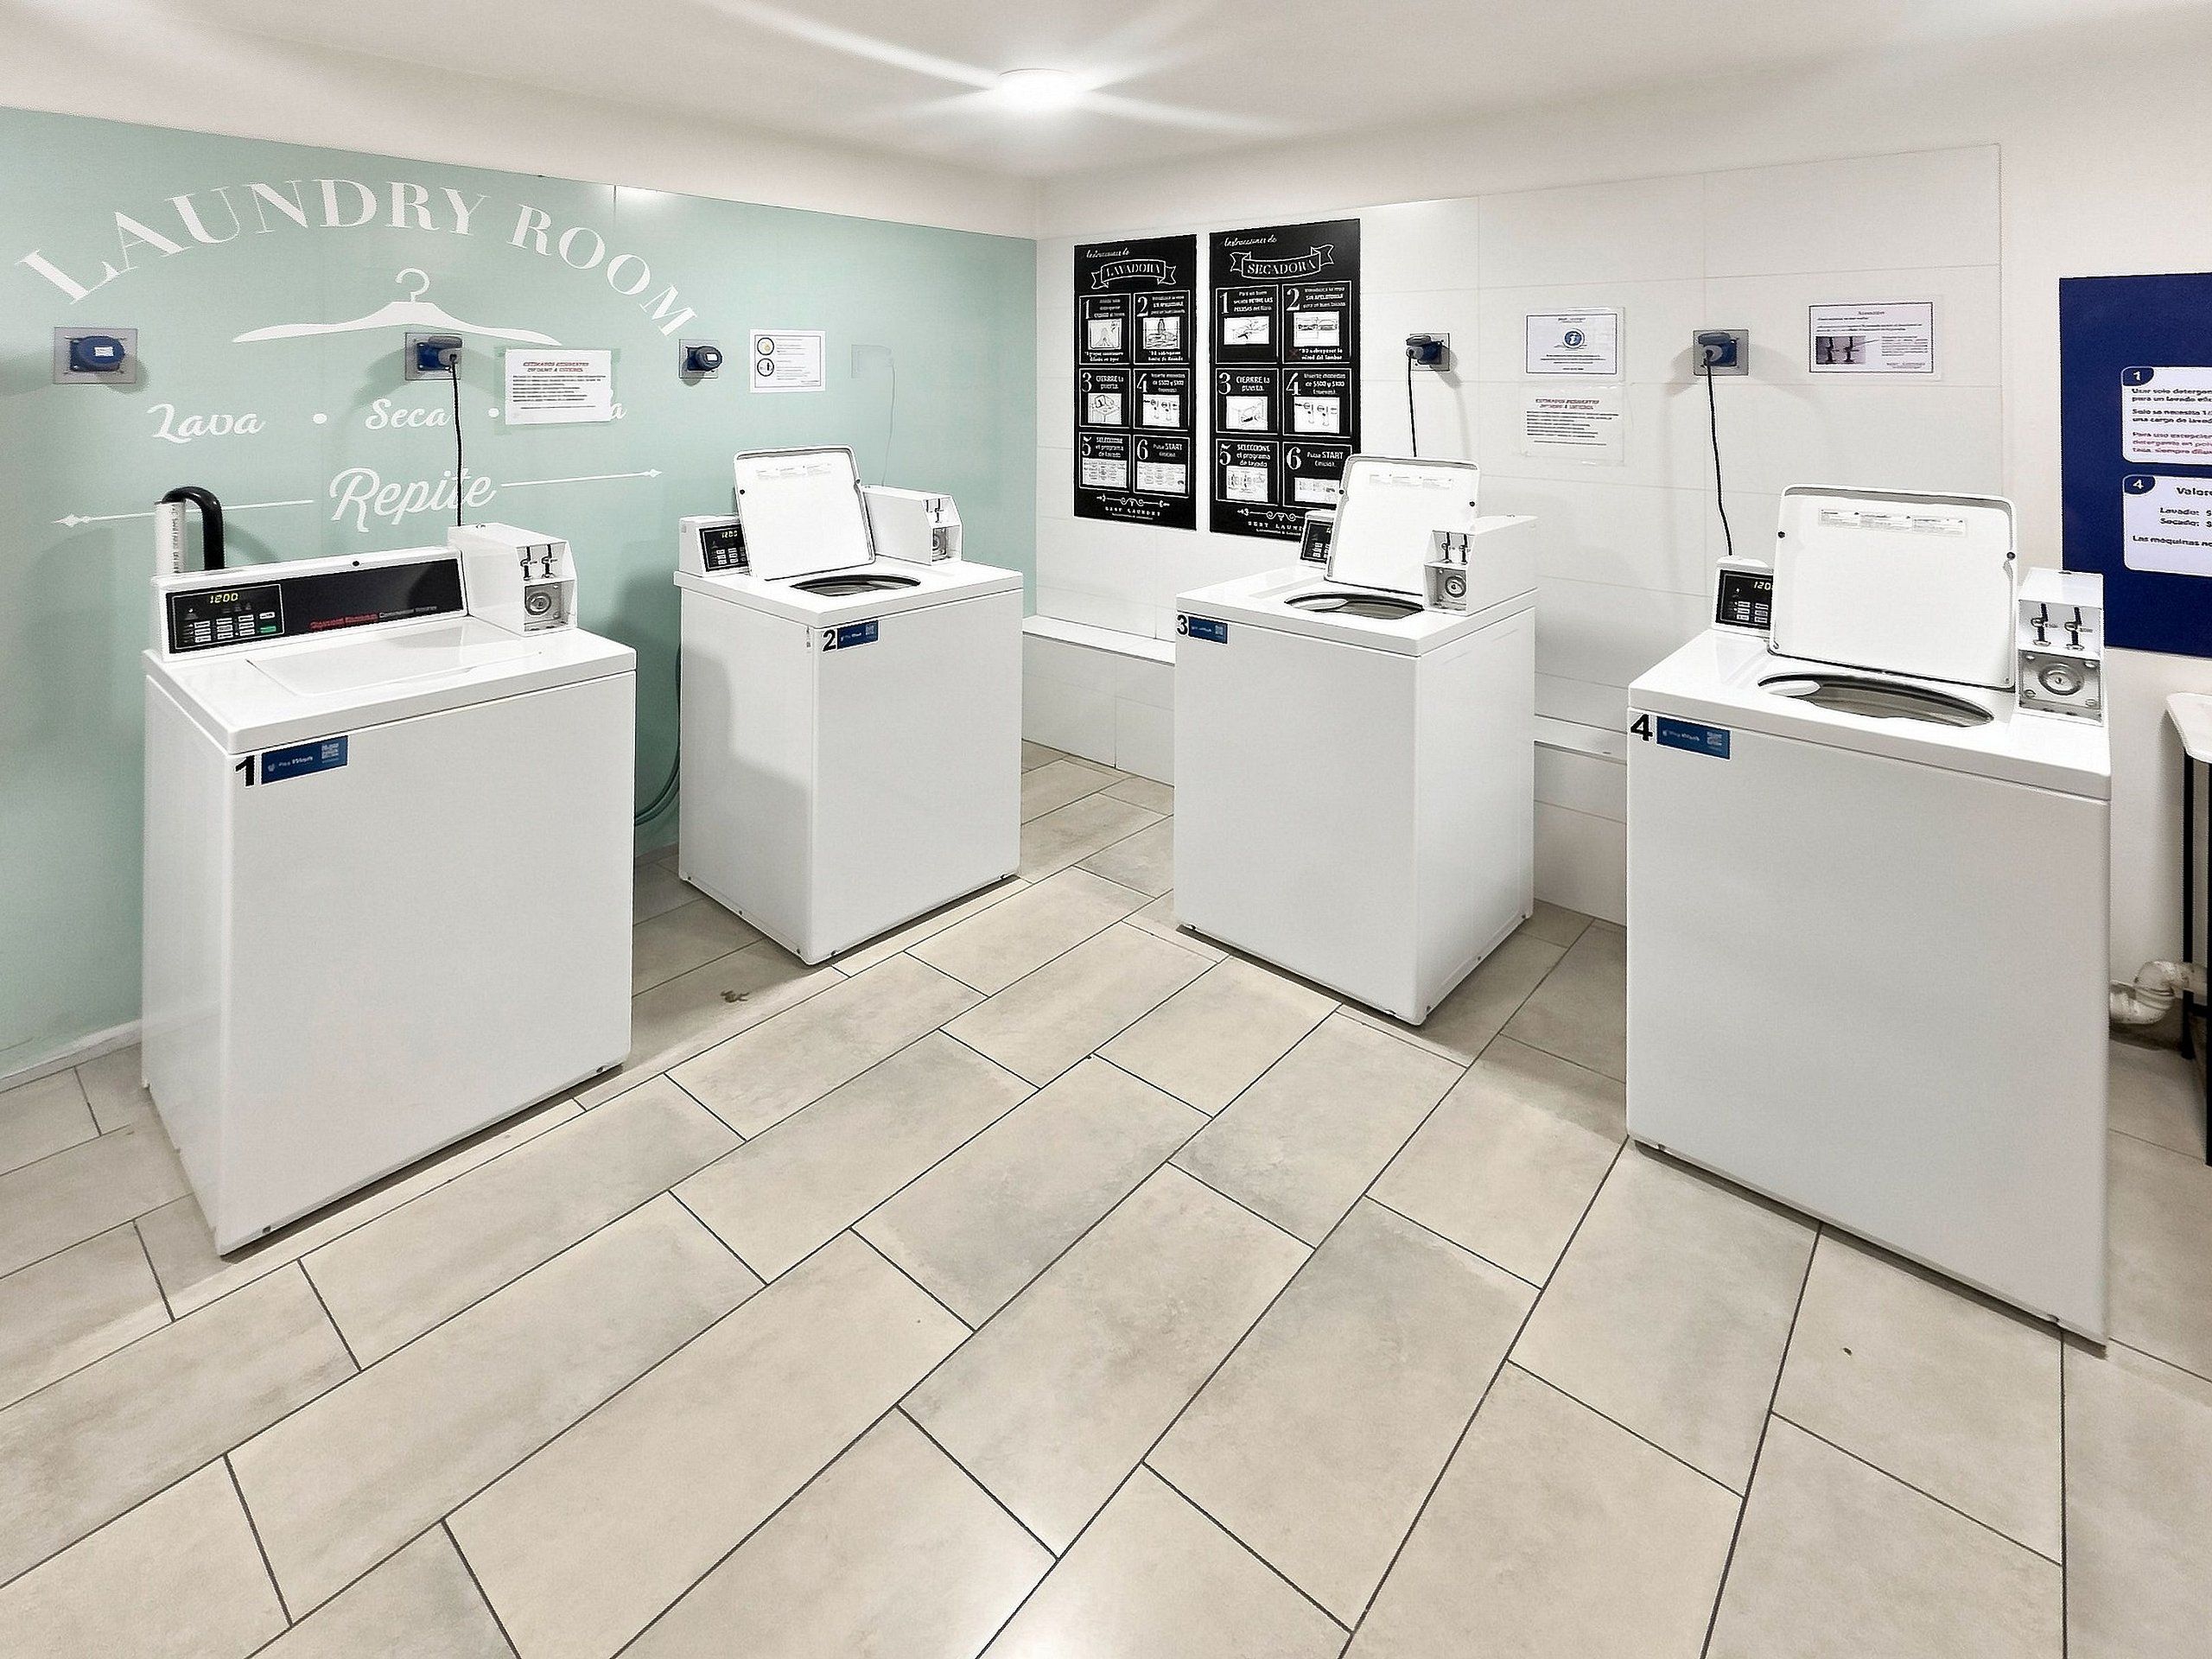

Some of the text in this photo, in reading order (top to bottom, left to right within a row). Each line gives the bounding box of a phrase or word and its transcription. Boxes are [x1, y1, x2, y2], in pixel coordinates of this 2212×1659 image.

[16, 178, 696, 336] LAUNDRY ROOM
[1247, 259, 1316, 275] SECADORA
[1107, 264, 1160, 276] LAVADORA
[1083, 299, 1092, 320] 1
[1137, 296, 1148, 316] 2
[1219, 291, 1229, 314] 1
[1286, 288, 1300, 311] 2
[1082, 372, 1092, 392] 3
[1137, 373, 1147, 392] 4
[1218, 372, 1230, 394] 3
[1286, 372, 1301, 396] 4
[2133, 371, 2141, 380] 1
[147, 397, 454, 443] Lava Seca
[1082, 436, 1092, 456] 5
[1137, 439, 1148, 460] 6
[1218, 443, 1231, 466] 5
[1321, 451, 1344, 460] START
[1287, 447, 1301, 470] 6
[2133, 479, 2144, 489] 4
[328, 465, 496, 533] Repite
[2160, 507, 2200, 516] Lavado:
[2160, 518, 2200, 526] Secado:
[1754, 582, 1772, 590] 120
[210, 593, 238, 603] 1200
[1176, 614, 1188, 635] 3
[822, 629, 836, 652] 2
[1630, 714, 1653, 741] 4
[235, 755, 255, 786] 1
